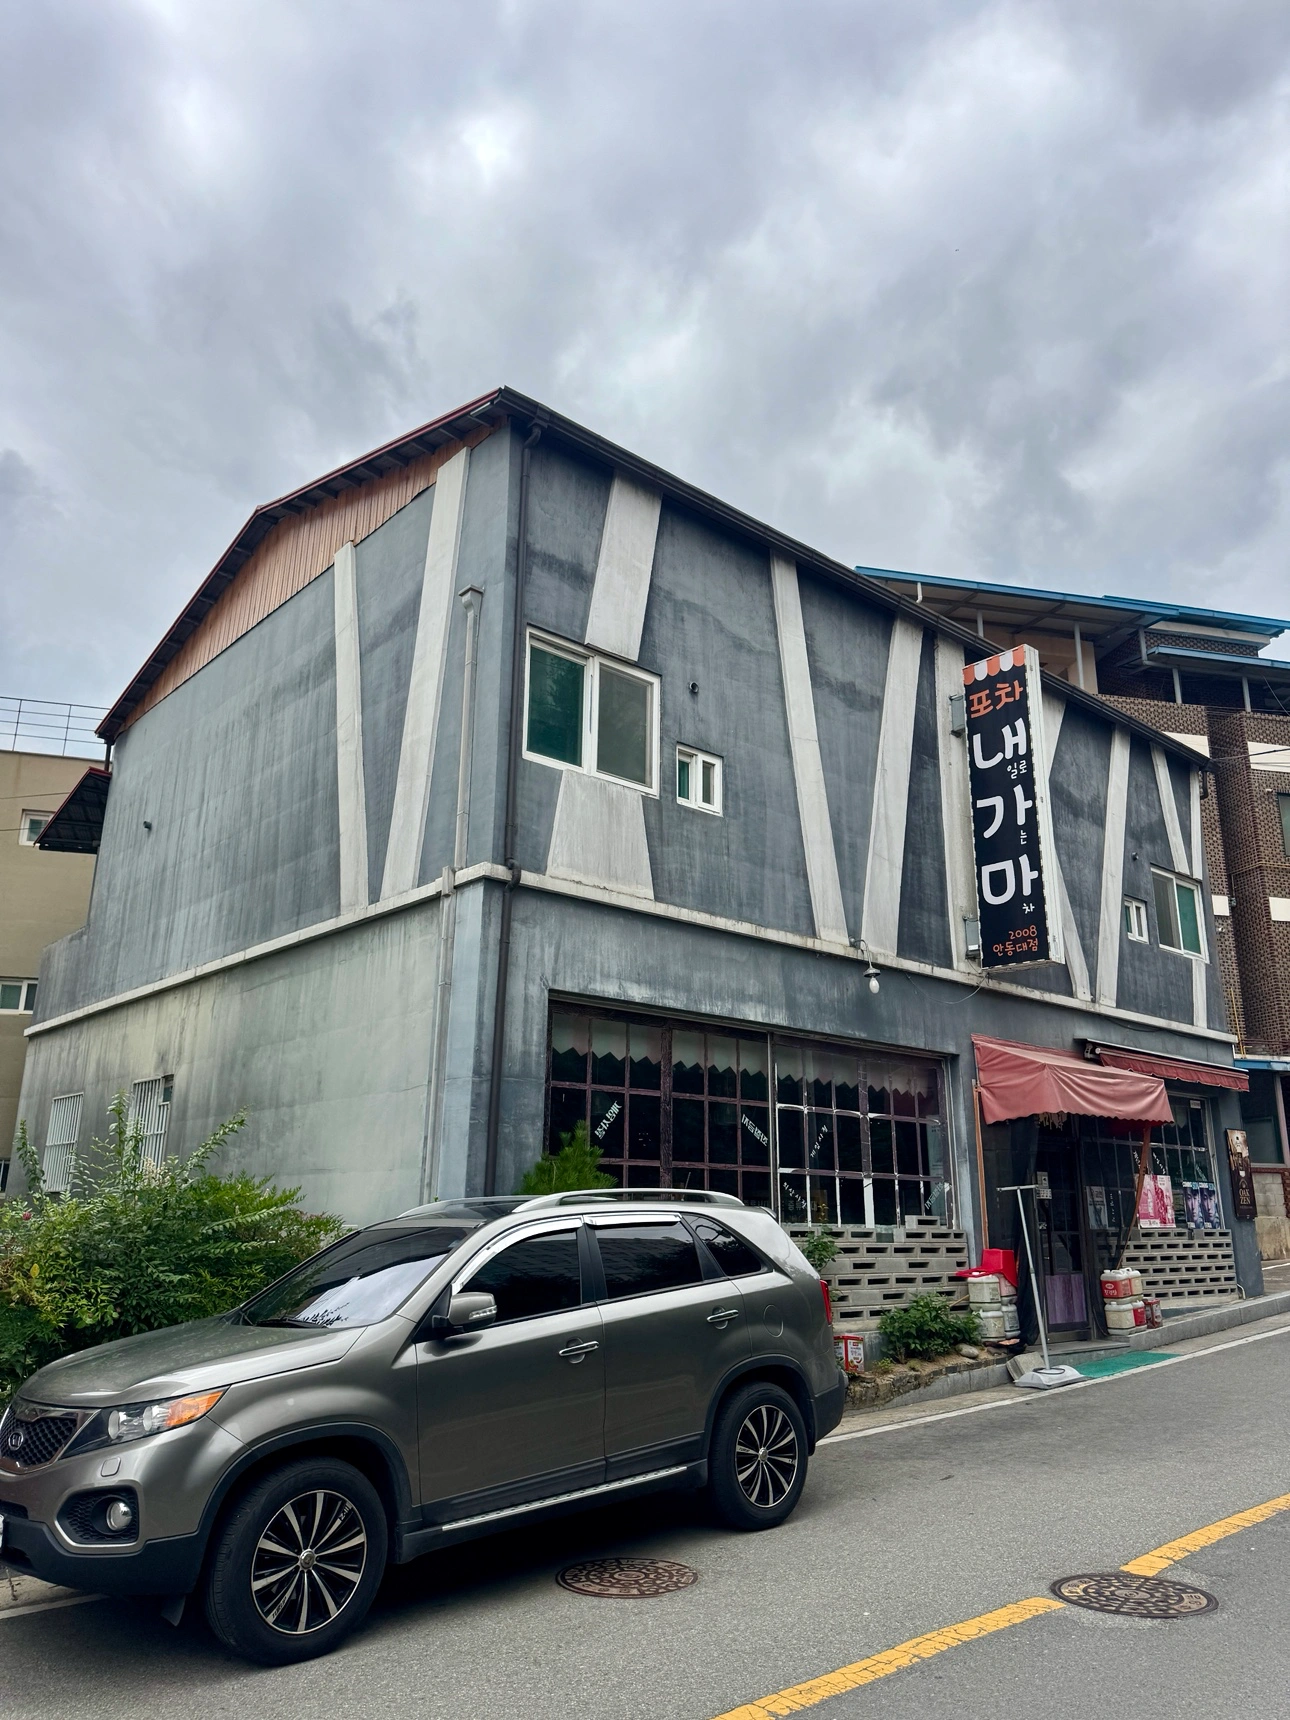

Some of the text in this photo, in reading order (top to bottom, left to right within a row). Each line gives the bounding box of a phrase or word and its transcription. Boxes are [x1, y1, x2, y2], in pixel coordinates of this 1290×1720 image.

[970, 680, 1023, 718] 포차
[973, 717, 1027, 769] 내
[1007, 760, 1027, 779] 일로
[977, 784, 1033, 838] 가
[1020, 830, 1027, 845] 는
[981, 854, 1039, 905] 마
[1022, 903, 1035, 914] 차
[1008, 925, 1038, 940] 2008
[993, 938, 1039, 956] 안동대점
[1239, 1188, 1250, 1197] OAK
[1240, 1196, 1251, 1205] ZEN
